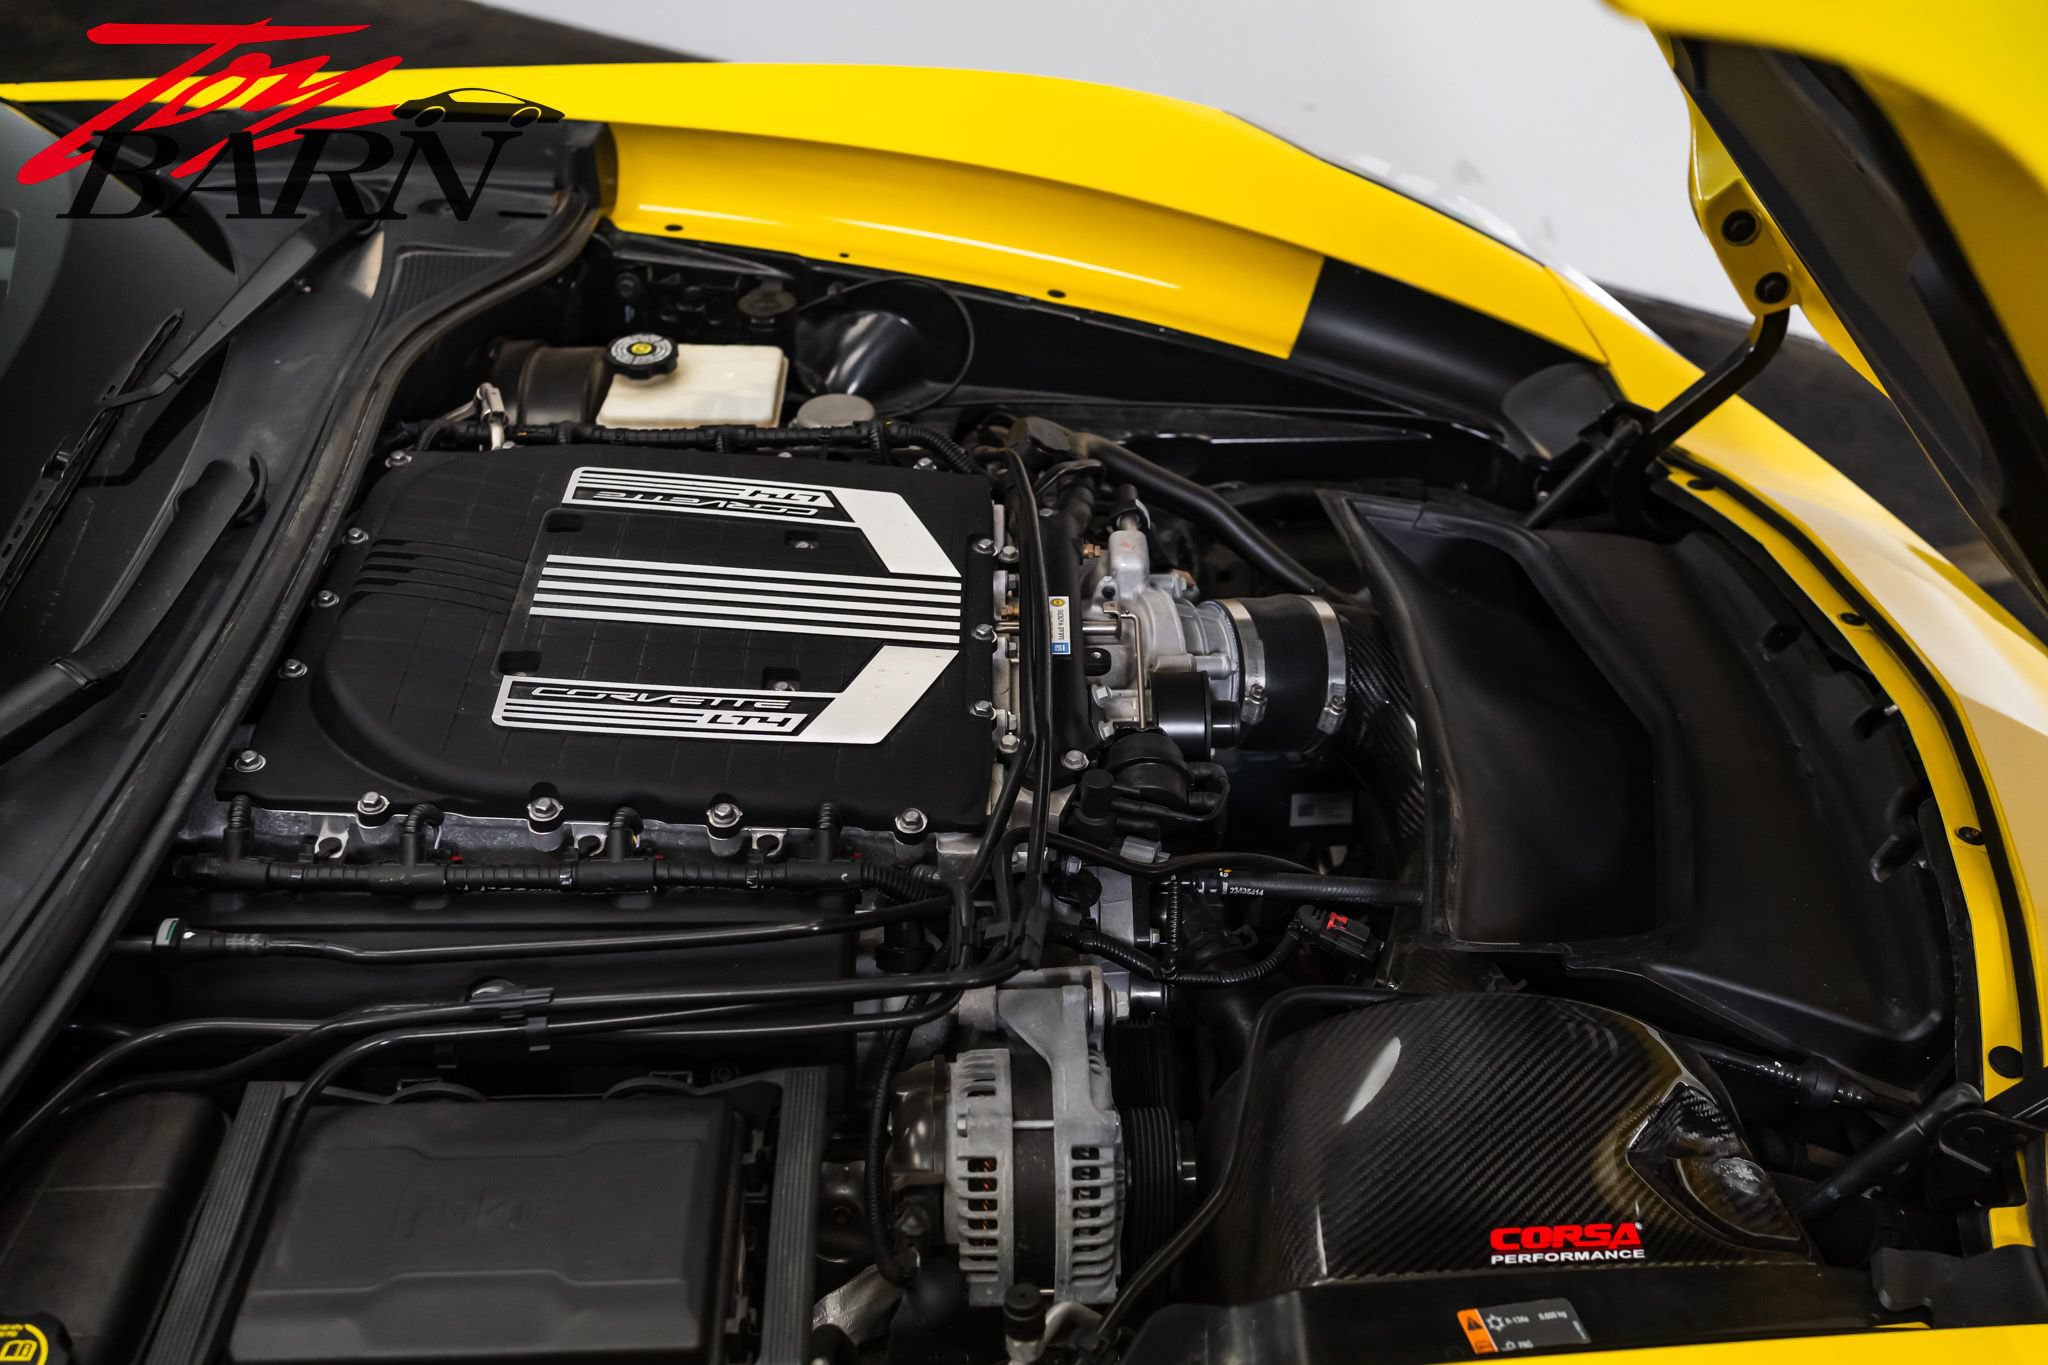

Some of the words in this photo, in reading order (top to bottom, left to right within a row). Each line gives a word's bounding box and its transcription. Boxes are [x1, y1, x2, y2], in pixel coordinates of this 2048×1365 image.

[592, 491, 819, 516] CORVETTE
[747, 489, 821, 502] LT4
[531, 686, 792, 710] CORVETTE
[707, 714, 792, 728] LT4
[1490, 1222, 1641, 1250] CORSA
[1491, 1249, 1645, 1265] PERFORMANCE
